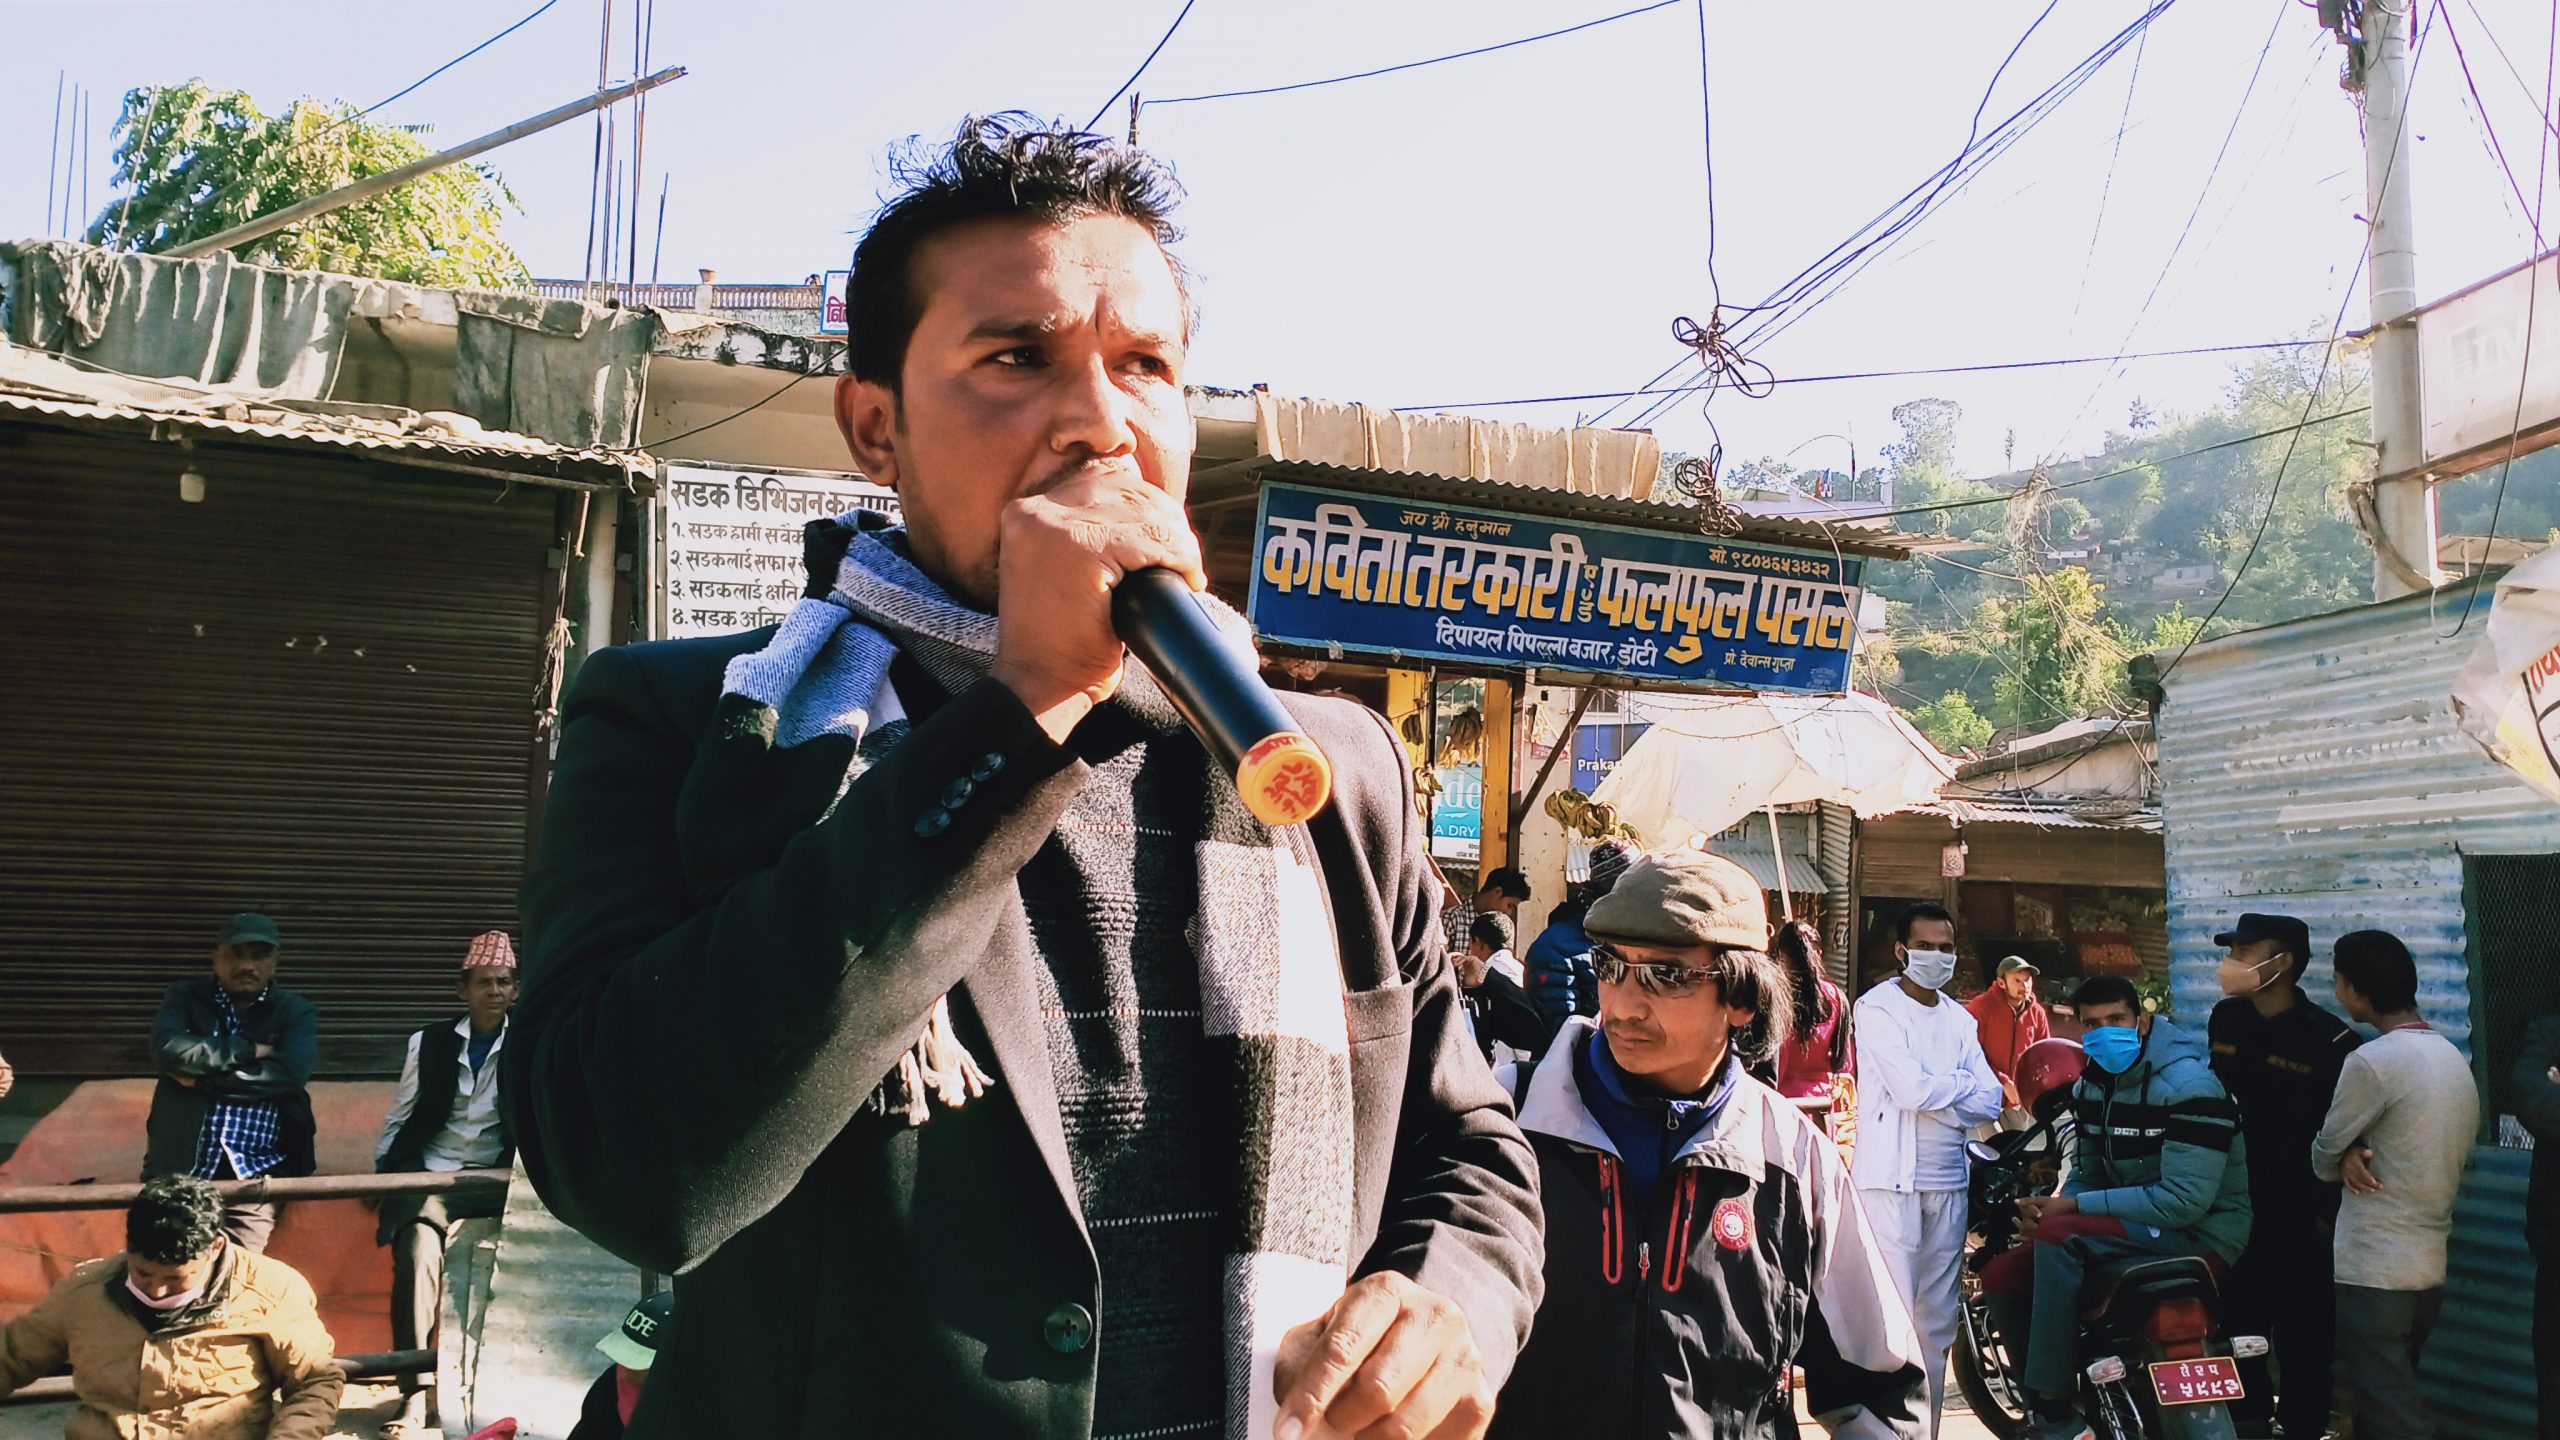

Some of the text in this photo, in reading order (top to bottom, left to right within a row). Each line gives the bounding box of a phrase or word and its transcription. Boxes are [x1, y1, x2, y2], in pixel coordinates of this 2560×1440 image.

[671, 480, 730, 510] सडक
[735, 475, 825, 516] डिभिजन
[687, 522, 728, 540] सडक
[1399, 510, 1512, 540] जय श्री हनुमान
[686, 548, 753, 572] सडकलाई
[754, 554, 786, 573] सफा
[689, 578, 763, 603] सडकलाई
[1263, 503, 1412, 605] कविता
[1403, 533, 1588, 622] तरकारी
[1597, 557, 1759, 665] फलफुल
[1756, 575, 1860, 650] पसल
[691, 609, 737, 630] सडक
[1617, 637, 1658, 667] डोटी
[1448, 825, 1476, 837] DRY
